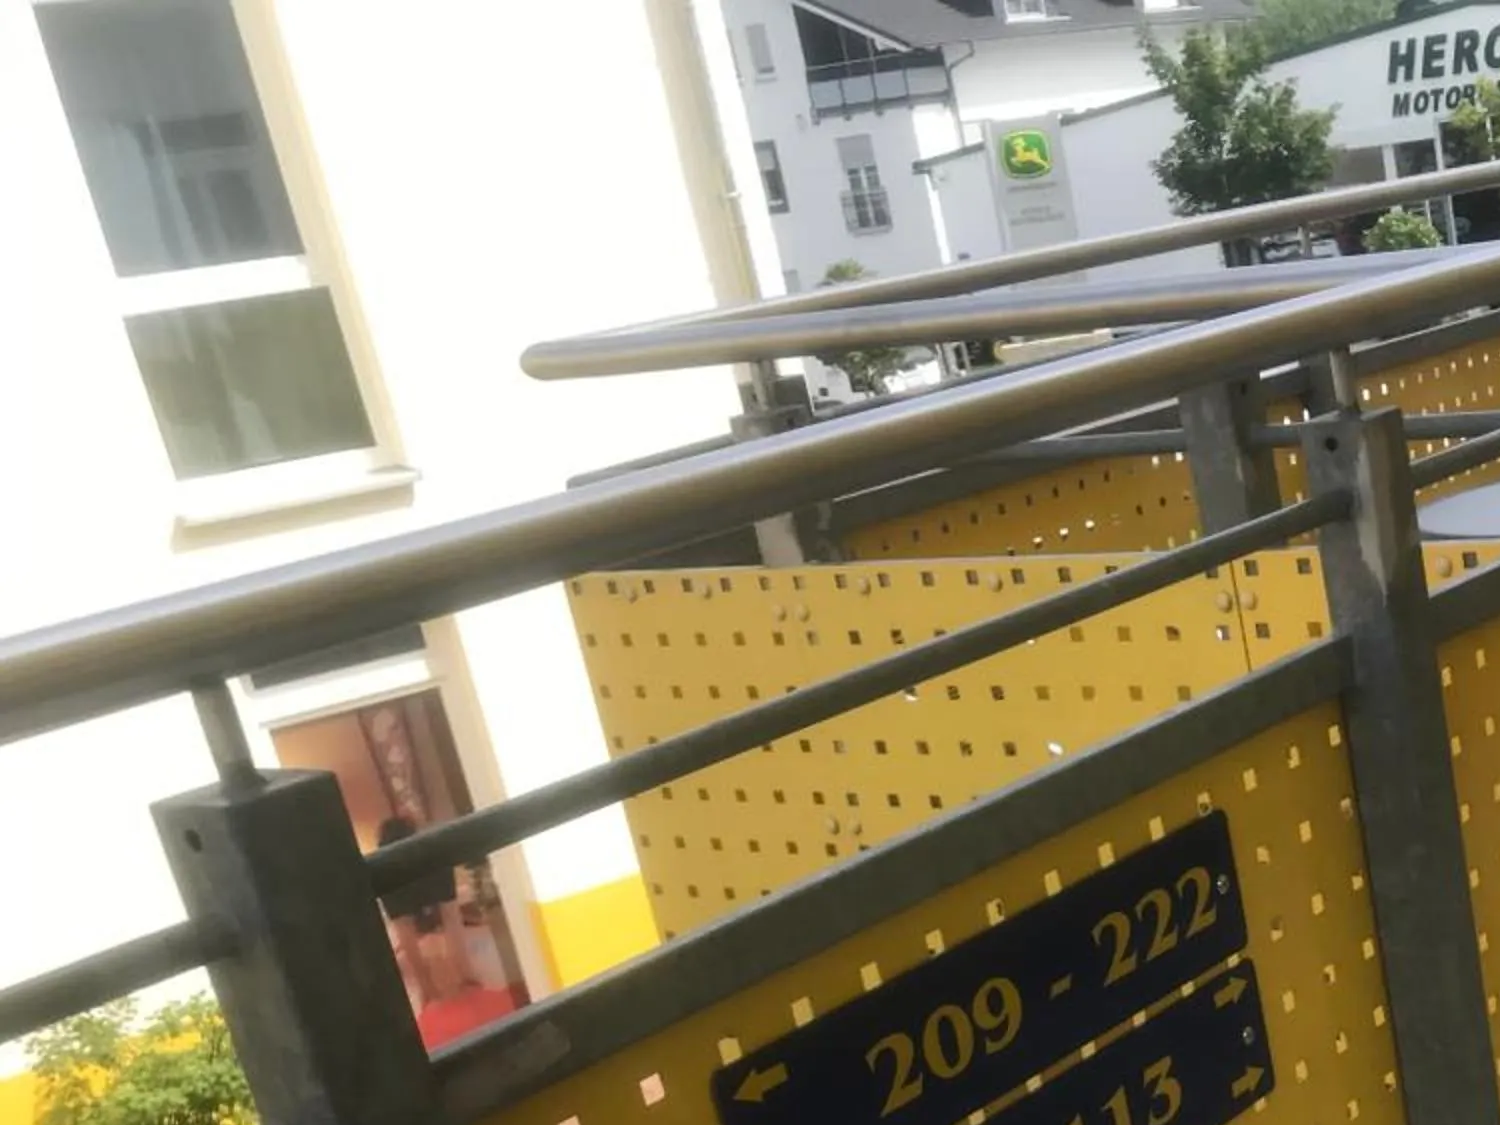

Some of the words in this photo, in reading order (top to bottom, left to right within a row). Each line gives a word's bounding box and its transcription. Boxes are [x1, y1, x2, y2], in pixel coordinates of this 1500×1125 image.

[865, 977, 1022, 1117] 209
[1049, 973, 1072, 999] -
[1091, 866, 1217, 988] 222
